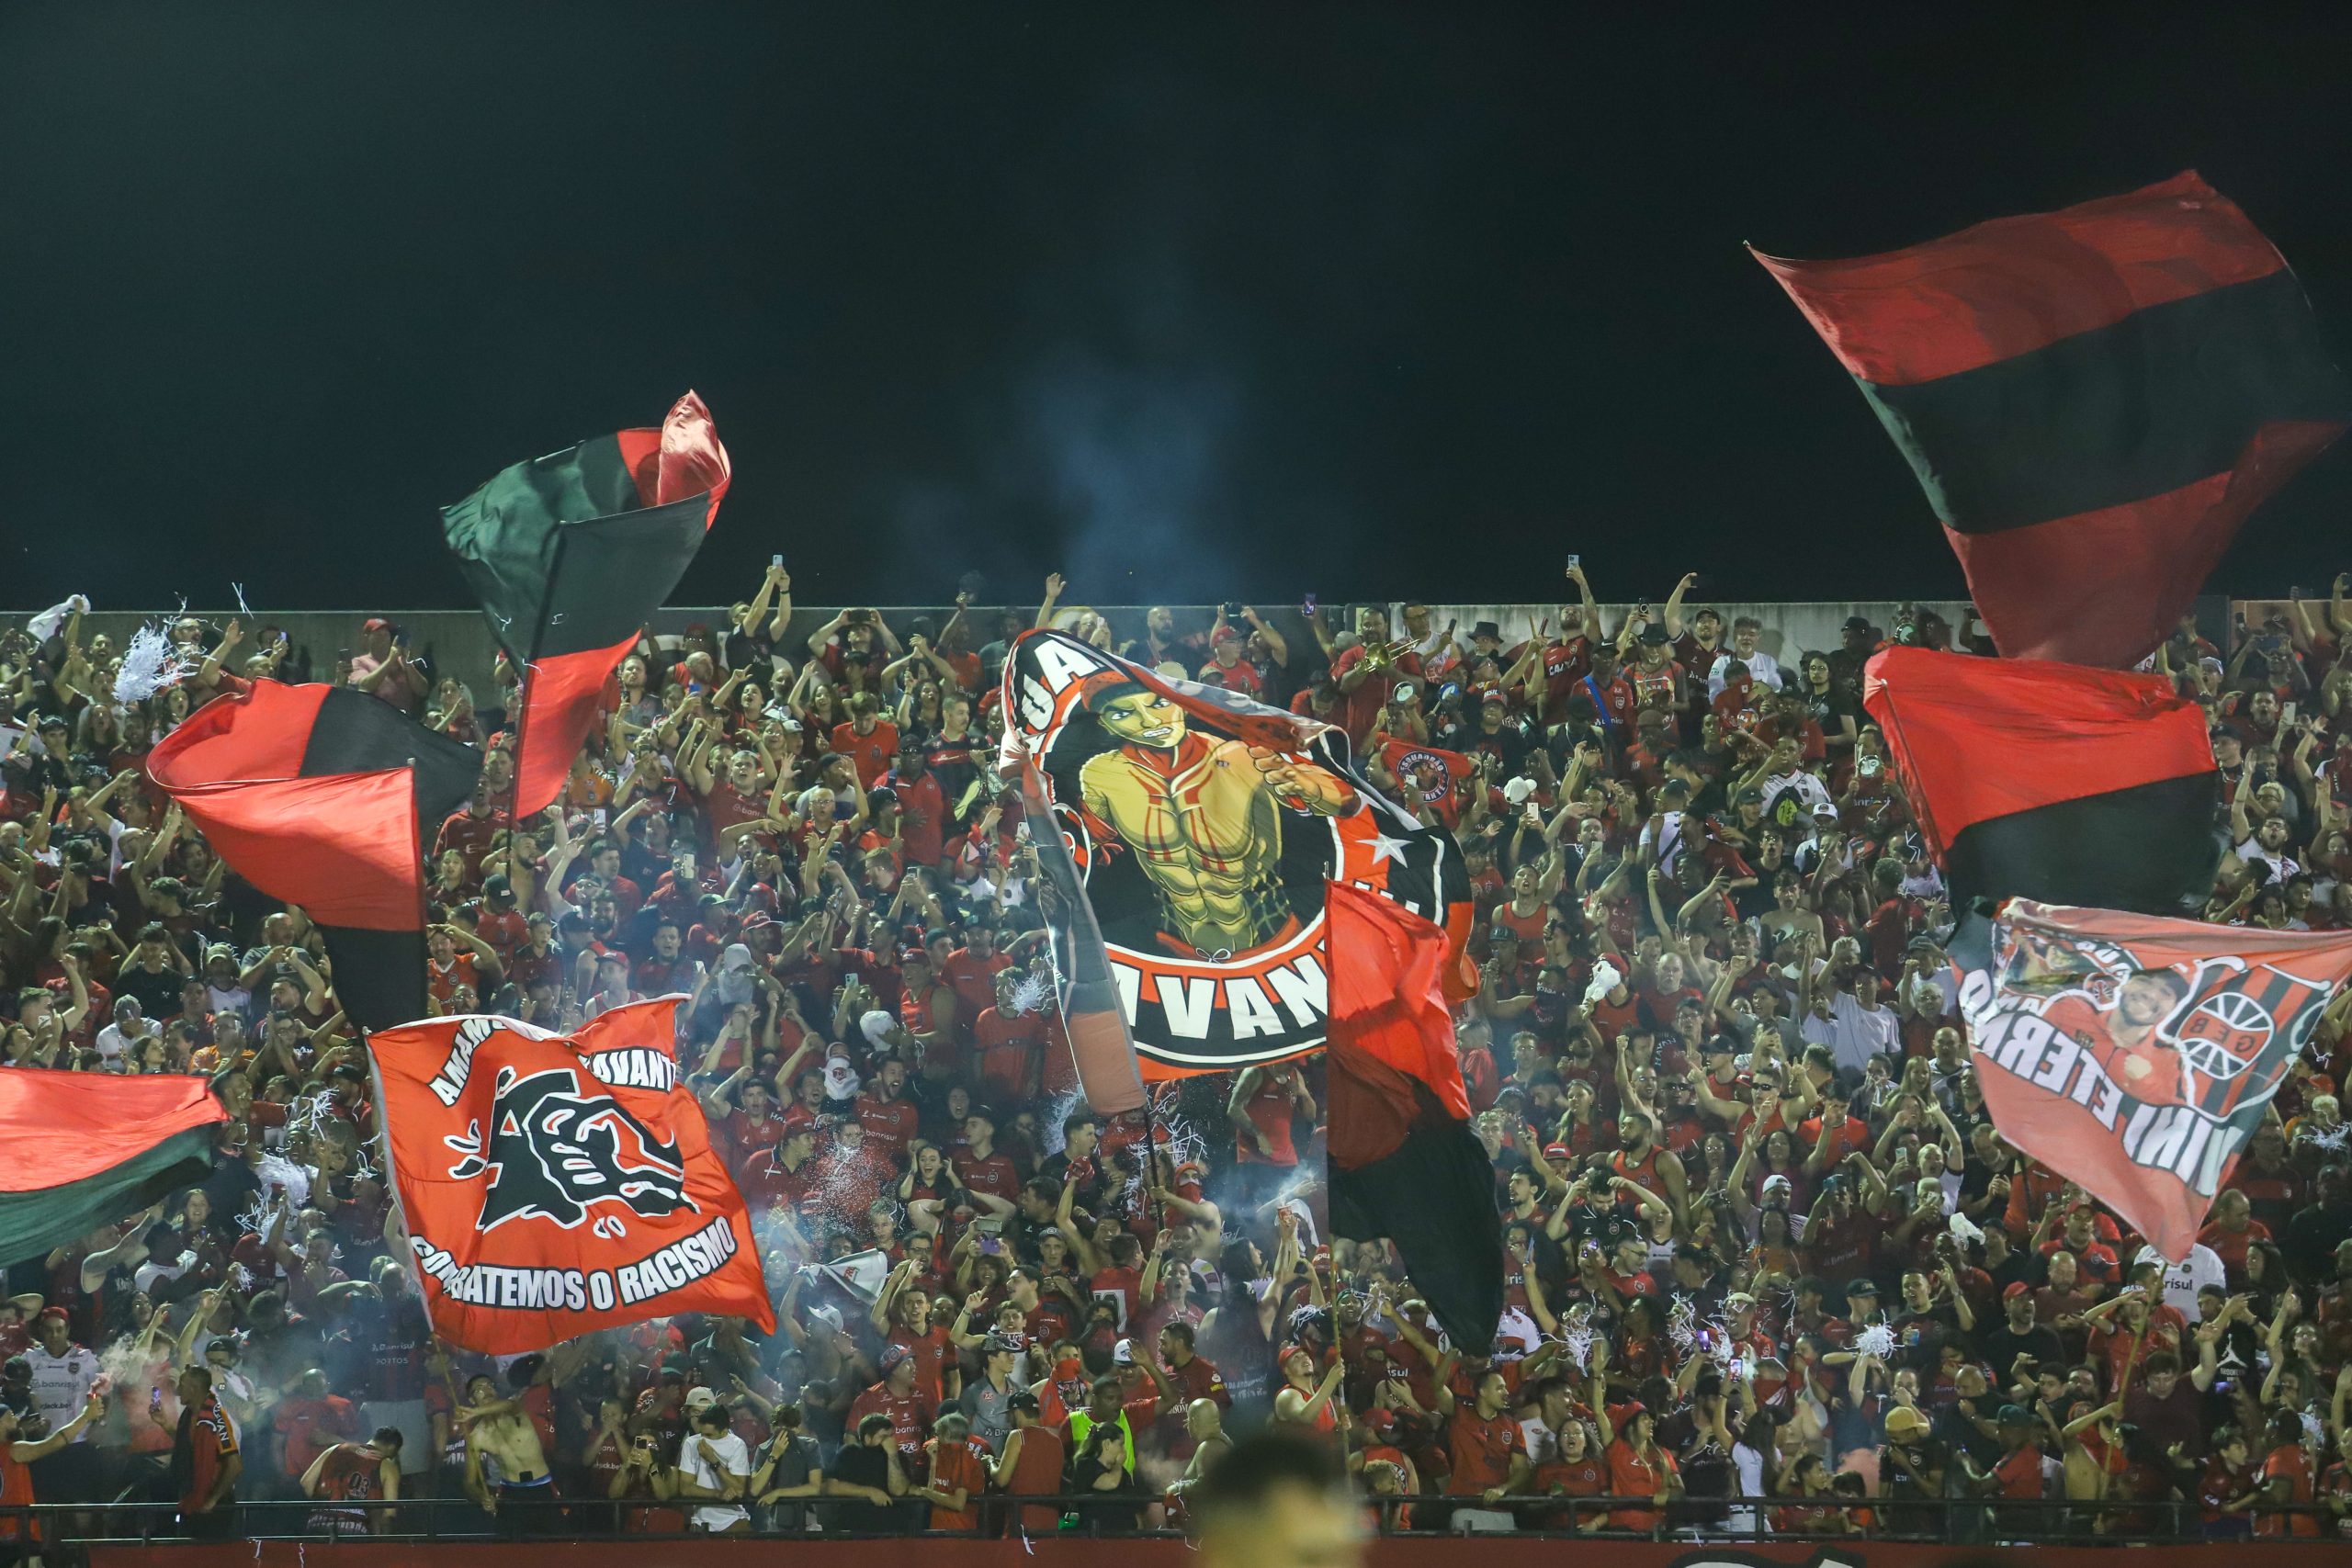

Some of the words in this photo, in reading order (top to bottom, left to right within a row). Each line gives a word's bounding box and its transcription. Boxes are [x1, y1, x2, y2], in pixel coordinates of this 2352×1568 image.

[589, 1271, 615, 1311] O
[616, 1216, 737, 1306] RACISMO
[2165, 1279, 2192, 1291] risul
